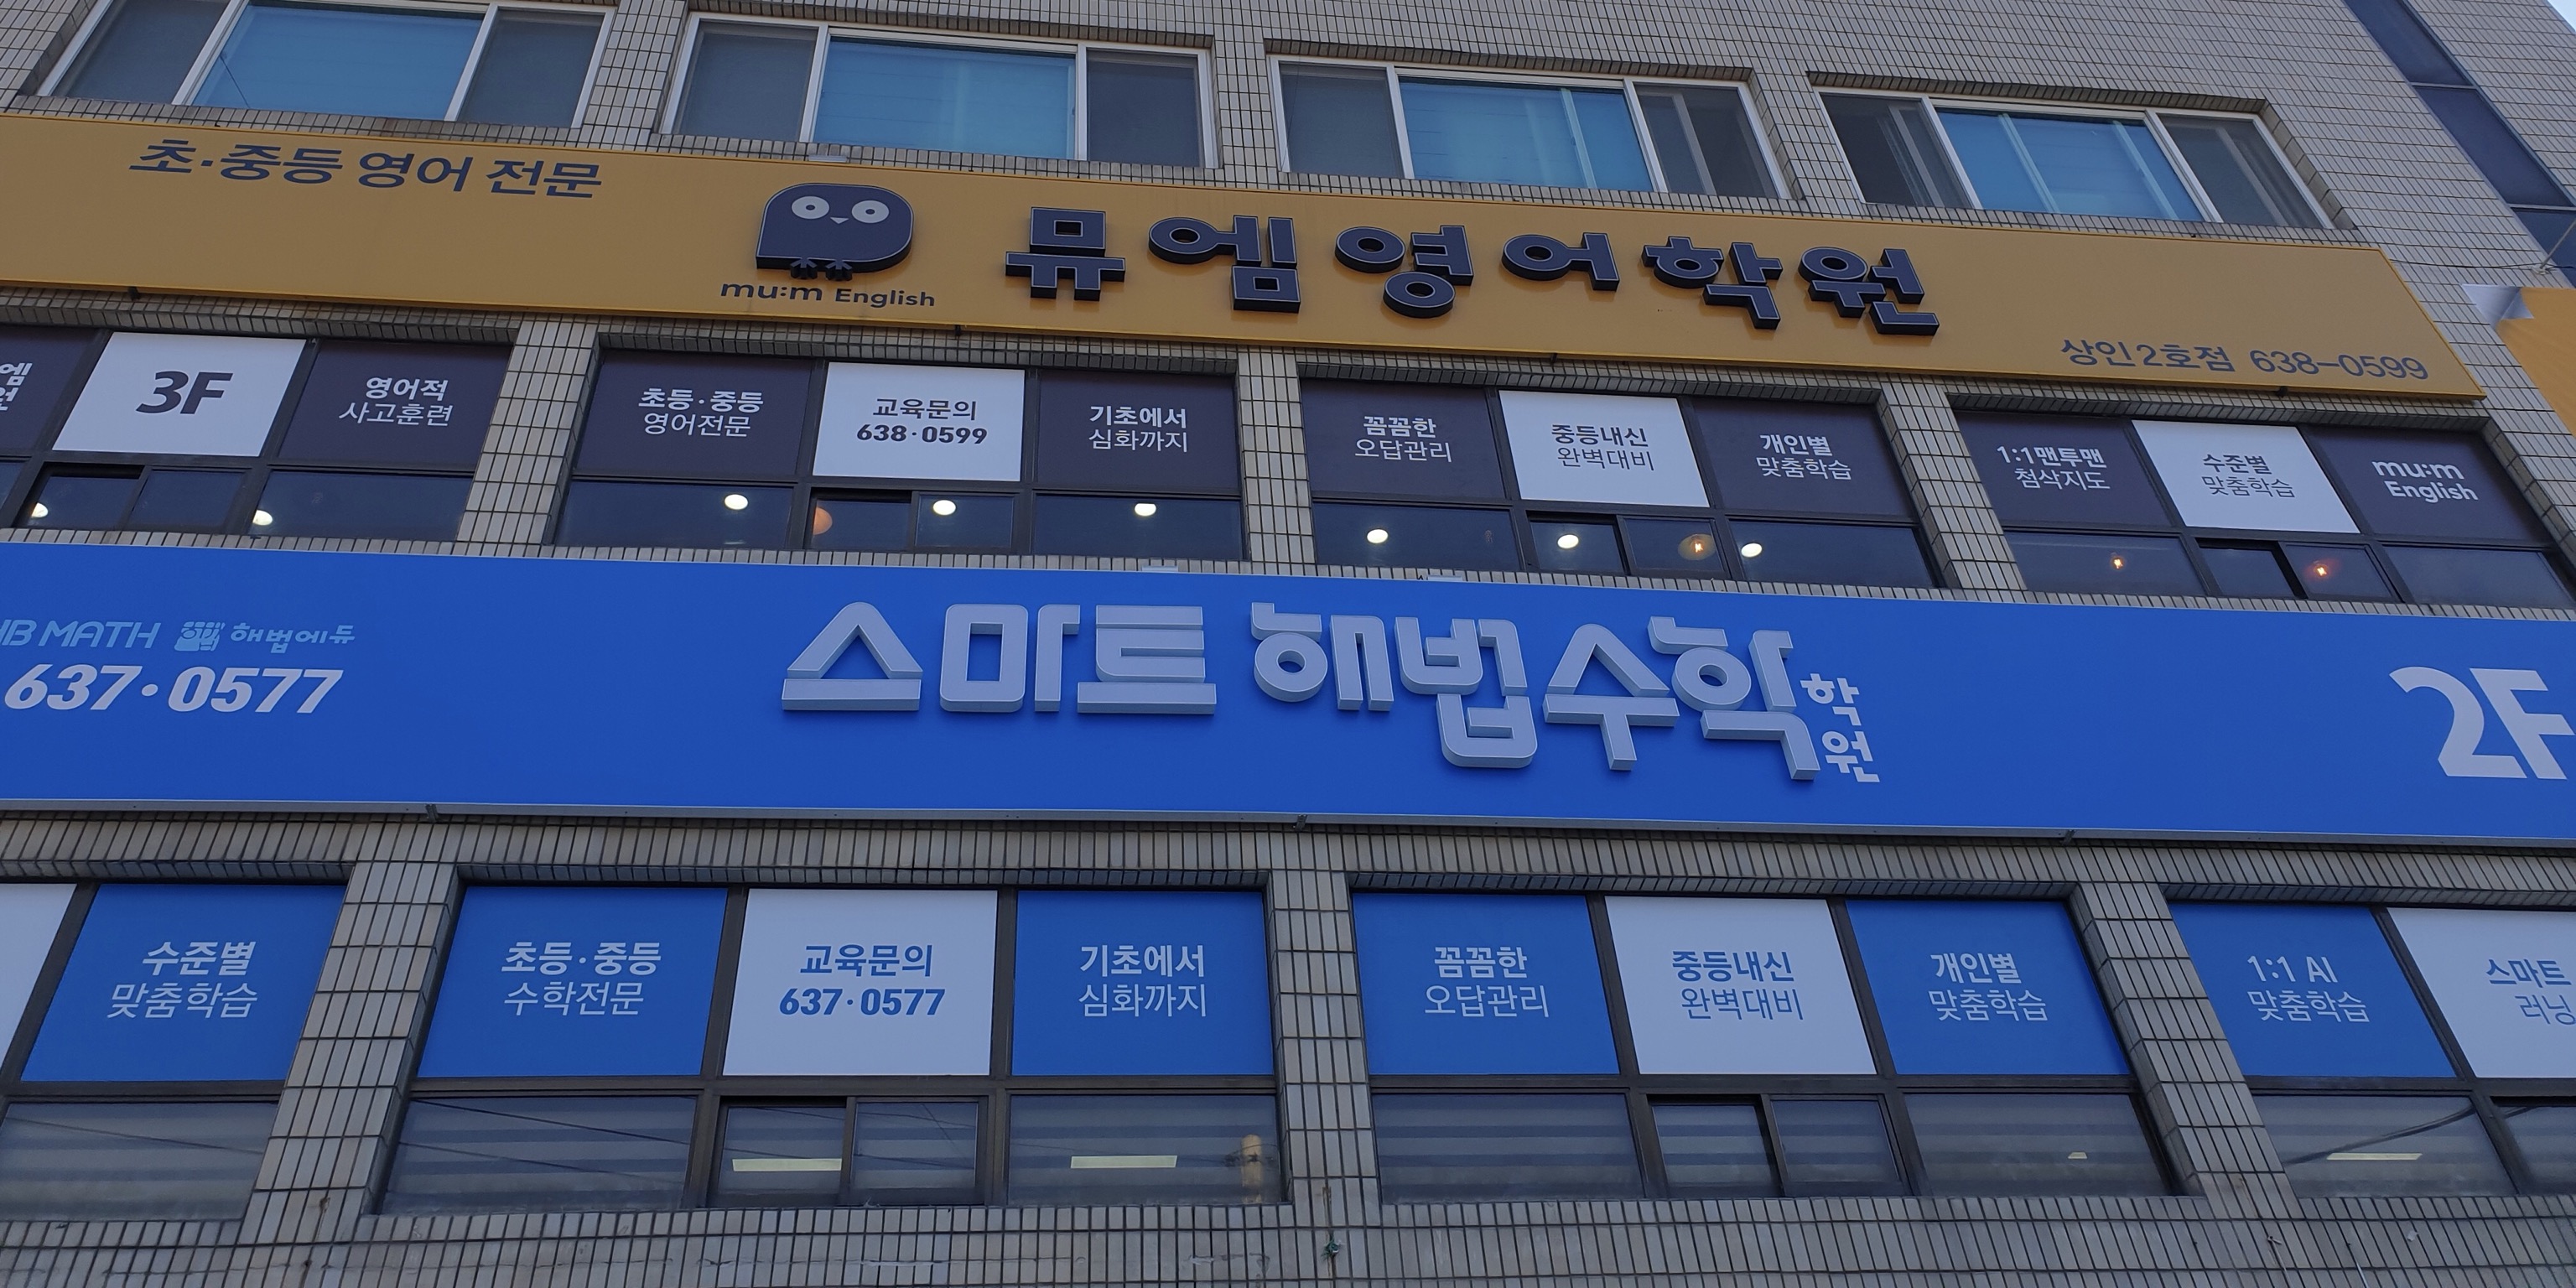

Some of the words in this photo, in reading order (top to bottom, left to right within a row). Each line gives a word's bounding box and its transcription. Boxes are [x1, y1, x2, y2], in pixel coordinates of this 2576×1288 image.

[359, 153, 473, 191] 영어
[486, 161, 601, 198] 전문
[720, 282, 823, 302] mu:m
[834, 288, 935, 308] English
[2060, 340, 2236, 373] 상인2호점
[2250, 350, 2428, 380] 638-0599
[136, 371, 233, 414] 3F
[365, 377, 449, 402] 영어적
[339, 402, 453, 426] 사고훈련
[873, 399, 976, 420] 교육문의
[1090, 406, 1186, 428] 기초에서
[645, 413, 750, 437] 영어전문
[1363, 417, 1436, 438] 꼼꼼한
[1552, 425, 1648, 449] 중등내신
[1089, 428, 1188, 453] 심화까지
[1355, 439, 1452, 463] 오답관리
[1759, 435, 1833, 457] 개인별
[1557, 448, 1654, 471] 완벽대비
[1757, 458, 1851, 480] 맞춤학습
[2203, 454, 2272, 474] 수준별
[2372, 462, 2464, 480] mu:m
[2015, 468, 2110, 491] 첨삭지도
[2202, 475, 2295, 498] 맞춤학습
[2384, 481, 2478, 502] English
[39, 621, 161, 648] MATH
[231, 623, 355, 653] 해법에듀
[782, 602, 1217, 714] 스마트
[1250, 602, 1820, 780] 해법수학
[1800, 673, 1880, 783] 학원
[2389, 666, 2576, 779] 2F
[143, 942, 256, 975] 수준별
[801, 945, 932, 976] 교육문의
[1080, 945, 1203, 977] 기초에서
[1435, 947, 1527, 978] 꼼꼼한
[1673, 951, 1794, 982] 중등내신
[1930, 953, 2021, 983] 개인별
[2247, 956, 2295, 981] 1:1
[2307, 957, 2338, 982] AI
[2486, 959, 2571, 988] 스마트
[107, 983, 257, 1018] 맞춤학습
[505, 982, 643, 1015] 수학전문
[1079, 984, 1206, 1016] 심화까지
[1426, 985, 1549, 1017] 오답관리
[1682, 989, 1803, 1020] 완벽대비
[1929, 989, 2047, 1021] 맞춤학습
[2247, 990, 2369, 1022] 맞춤학습
[2515, 995, 2576, 1025] 러닝
